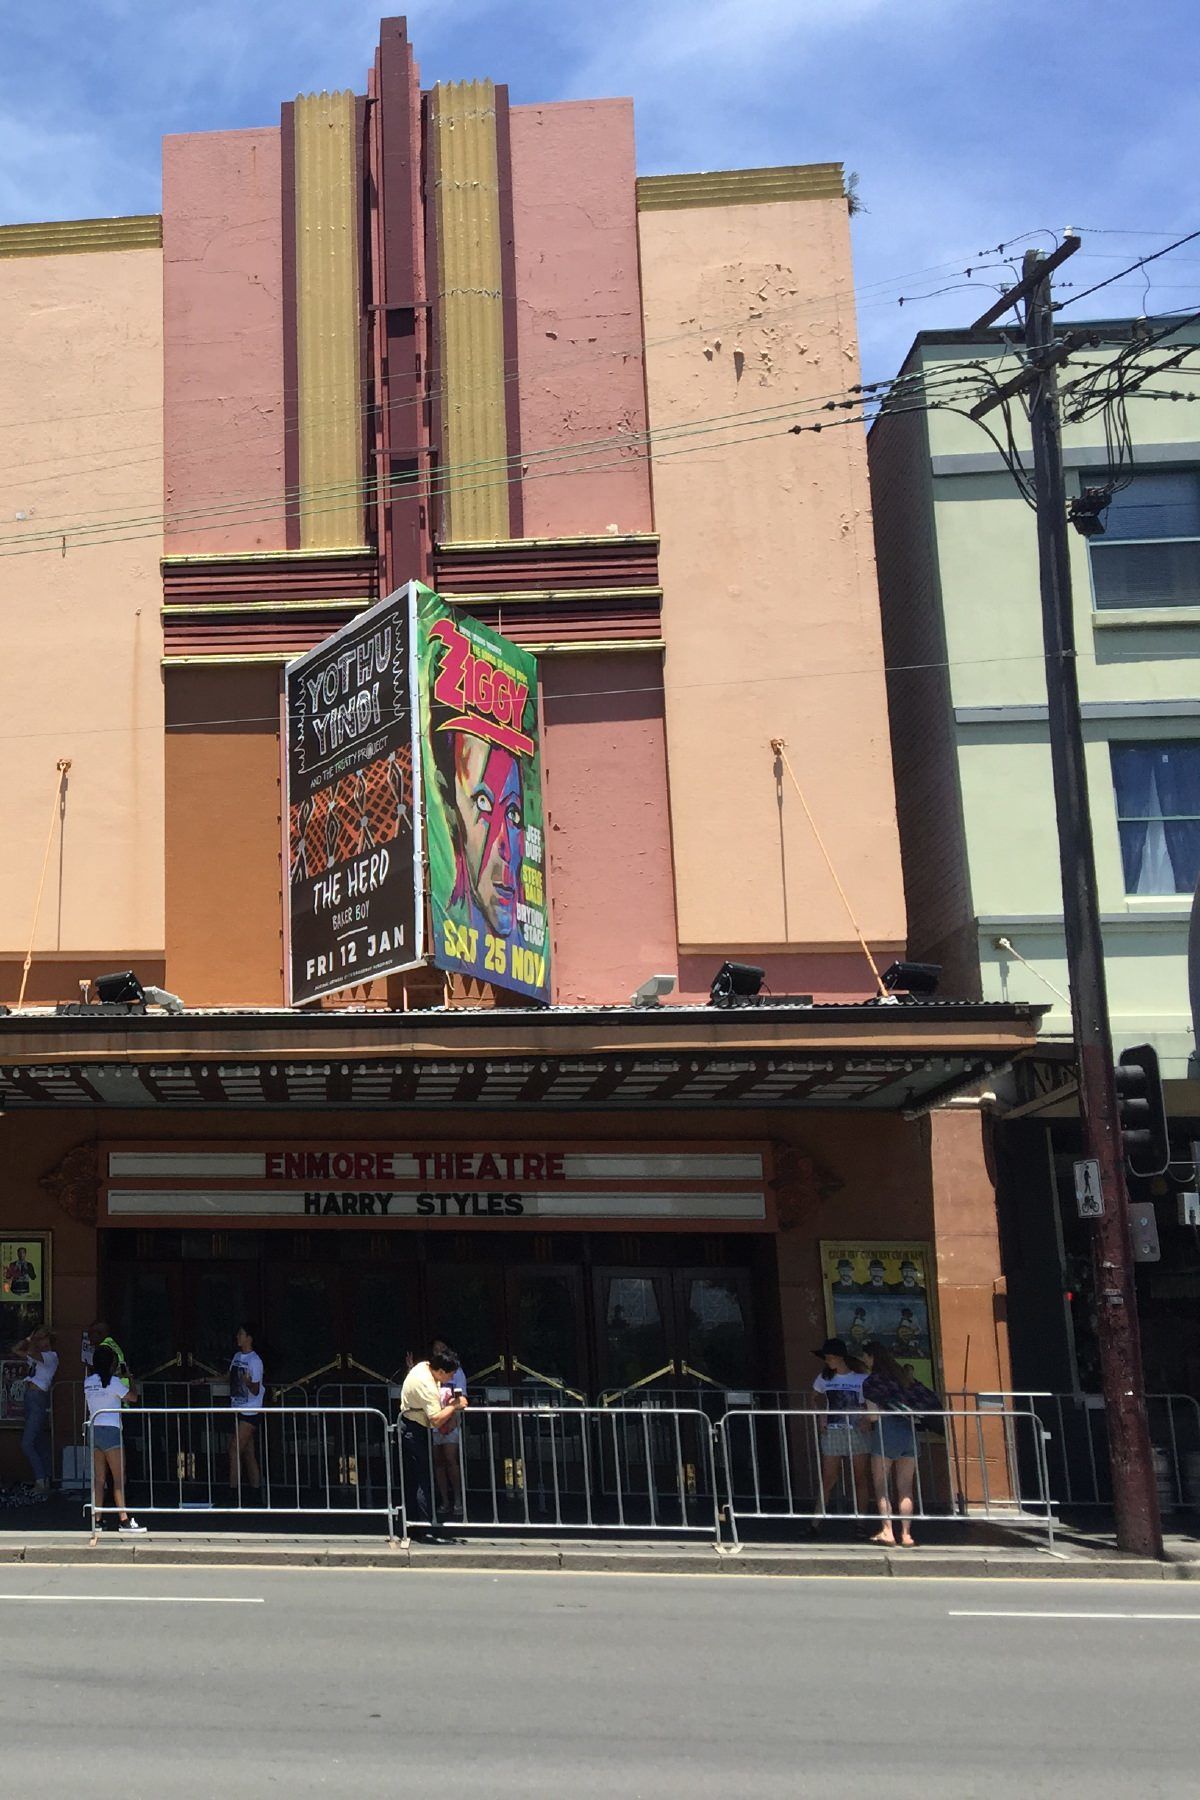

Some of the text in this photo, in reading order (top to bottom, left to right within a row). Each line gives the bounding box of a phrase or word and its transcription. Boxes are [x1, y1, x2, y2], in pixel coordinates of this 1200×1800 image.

[307, 626, 392, 714] YOTHU
[428, 618, 529, 732] ZIGGY
[312, 681, 381, 756] YINDI
[357, 735, 389, 763] PROJECT
[313, 848, 390, 915] THE HERD
[332, 900, 370, 931] BAKER BOY
[306, 951, 333, 980] FRI
[340, 941, 357, 967] 12
[367, 924, 404, 957] JAN
[443, 919, 545, 988] SAT 25 NOV
[265, 1151, 566, 1180] ENMORE THEATRE
[304, 1192, 524, 1216] HARRY STYLES
